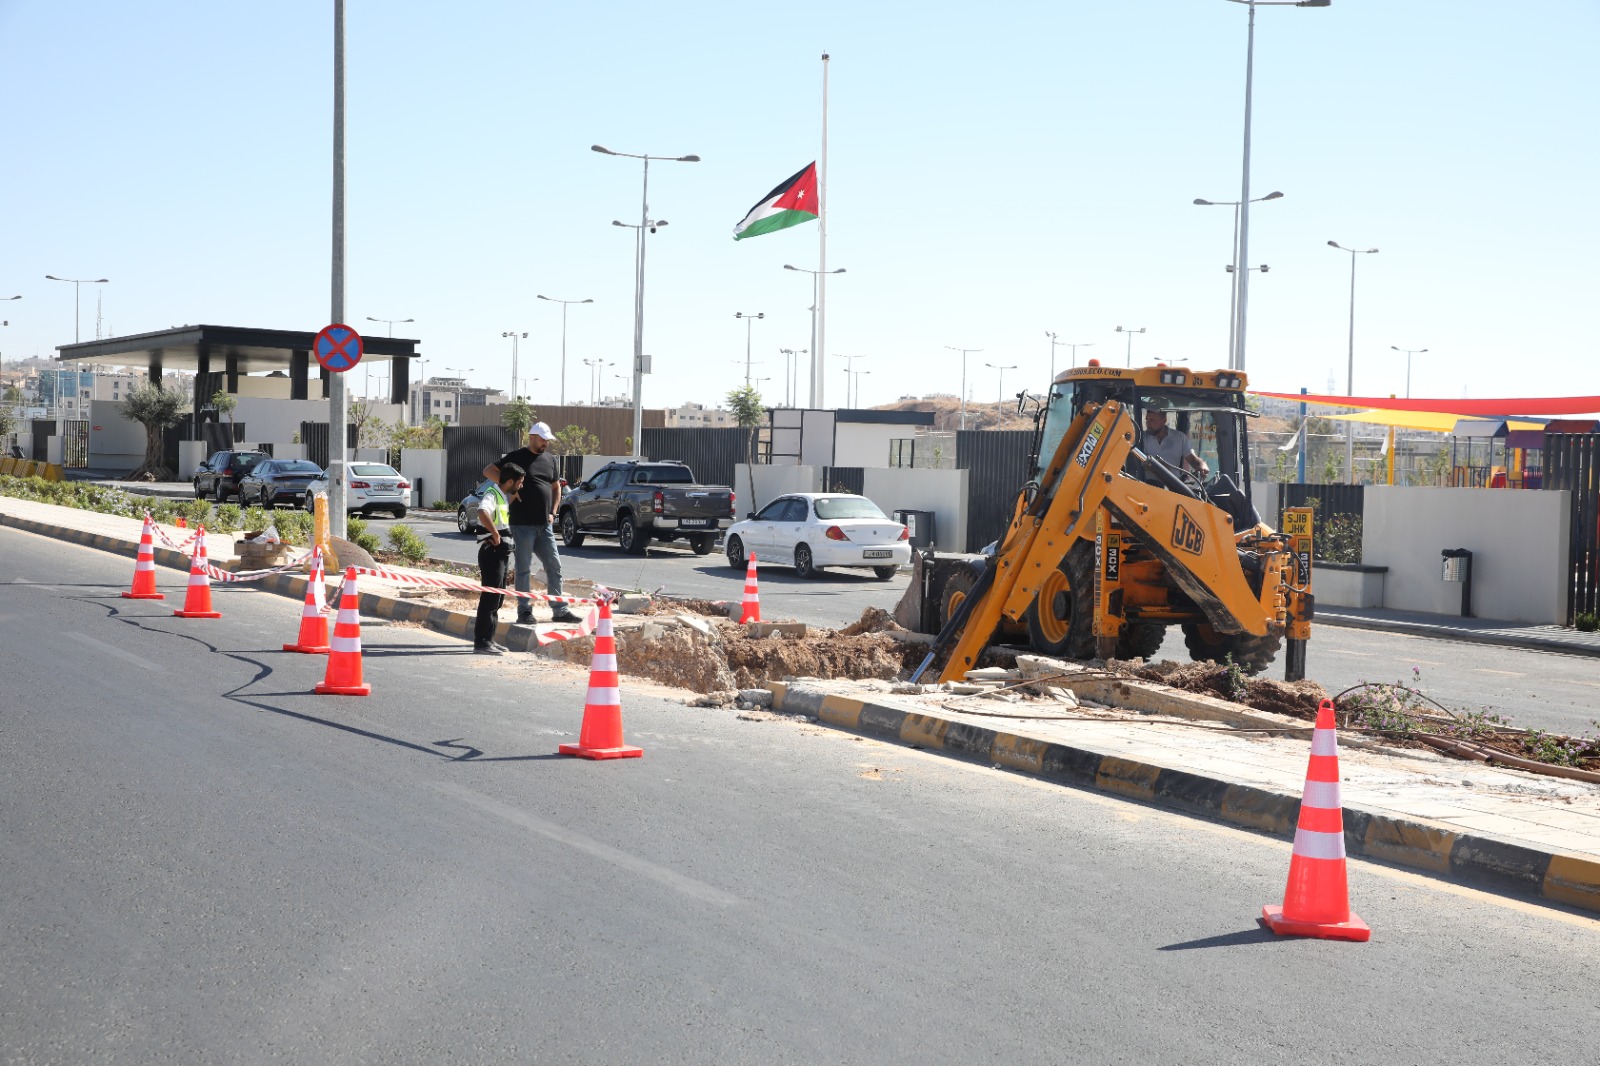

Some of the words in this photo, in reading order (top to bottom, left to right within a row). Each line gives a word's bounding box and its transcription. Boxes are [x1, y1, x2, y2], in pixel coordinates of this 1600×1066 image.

[1078, 433, 1098, 463] 3CX
[1175, 512, 1202, 552] JCB
[1289, 525, 1306, 533] JHK
[1108, 548, 1117, 573] 3CX
